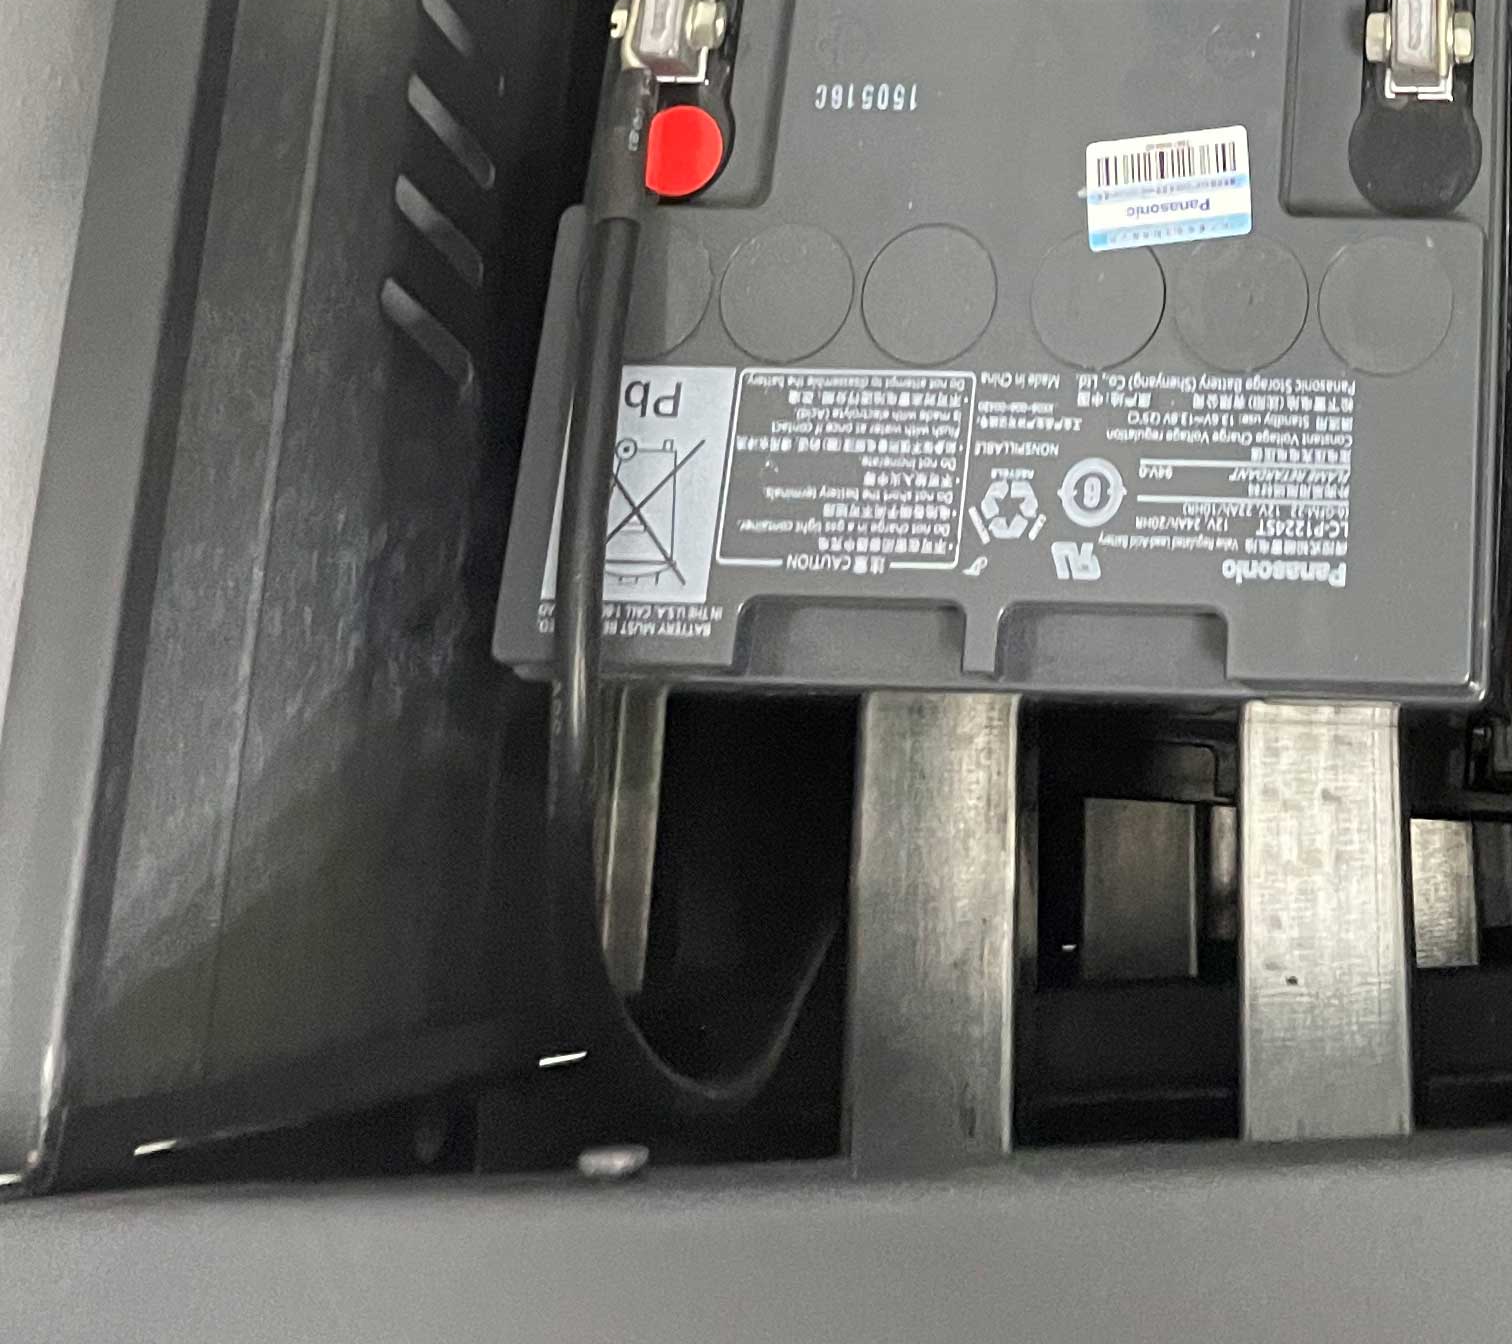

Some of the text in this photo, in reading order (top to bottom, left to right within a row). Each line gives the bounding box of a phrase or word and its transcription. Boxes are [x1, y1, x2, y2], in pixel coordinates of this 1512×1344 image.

[814, 83, 917, 110] 150516C
[1126, 197, 1210, 219] Panasonic
[981, 371, 1011, 388] China
[1028, 372, 1059, 388] Made
[1199, 373, 1242, 391] Battery
[1246, 374, 1291, 392] Storage
[1295, 378, 1354, 393] Panasonic
[624, 380, 682, 418] Pb
[892, 409, 915, 421] with
[919, 409, 950, 421] made
[1264, 412, 1309, 428] Standby
[771, 421, 811, 433] contact
[826, 422, 852, 431] once
[869, 423, 901, 435] water
[905, 423, 928, 436] with
[1107, 427, 1352, 445] Constant Voltage Charge Voltage regulation
[974, 440, 1058, 456] NONSPILLABLE
[819, 486, 858, 500] battery
[883, 489, 911, 501] short
[870, 518, 909, 533] charge
[1255, 517, 1348, 535] LC-P1224ST
[786, 553, 851, 569] CAUTION
[1221, 558, 1346, 586] Panasonic
[623, 604, 650, 617] CALL
[687, 605, 709, 618] THE
[620, 621, 655, 634] MUST
[657, 621, 710, 635] BATTERY
